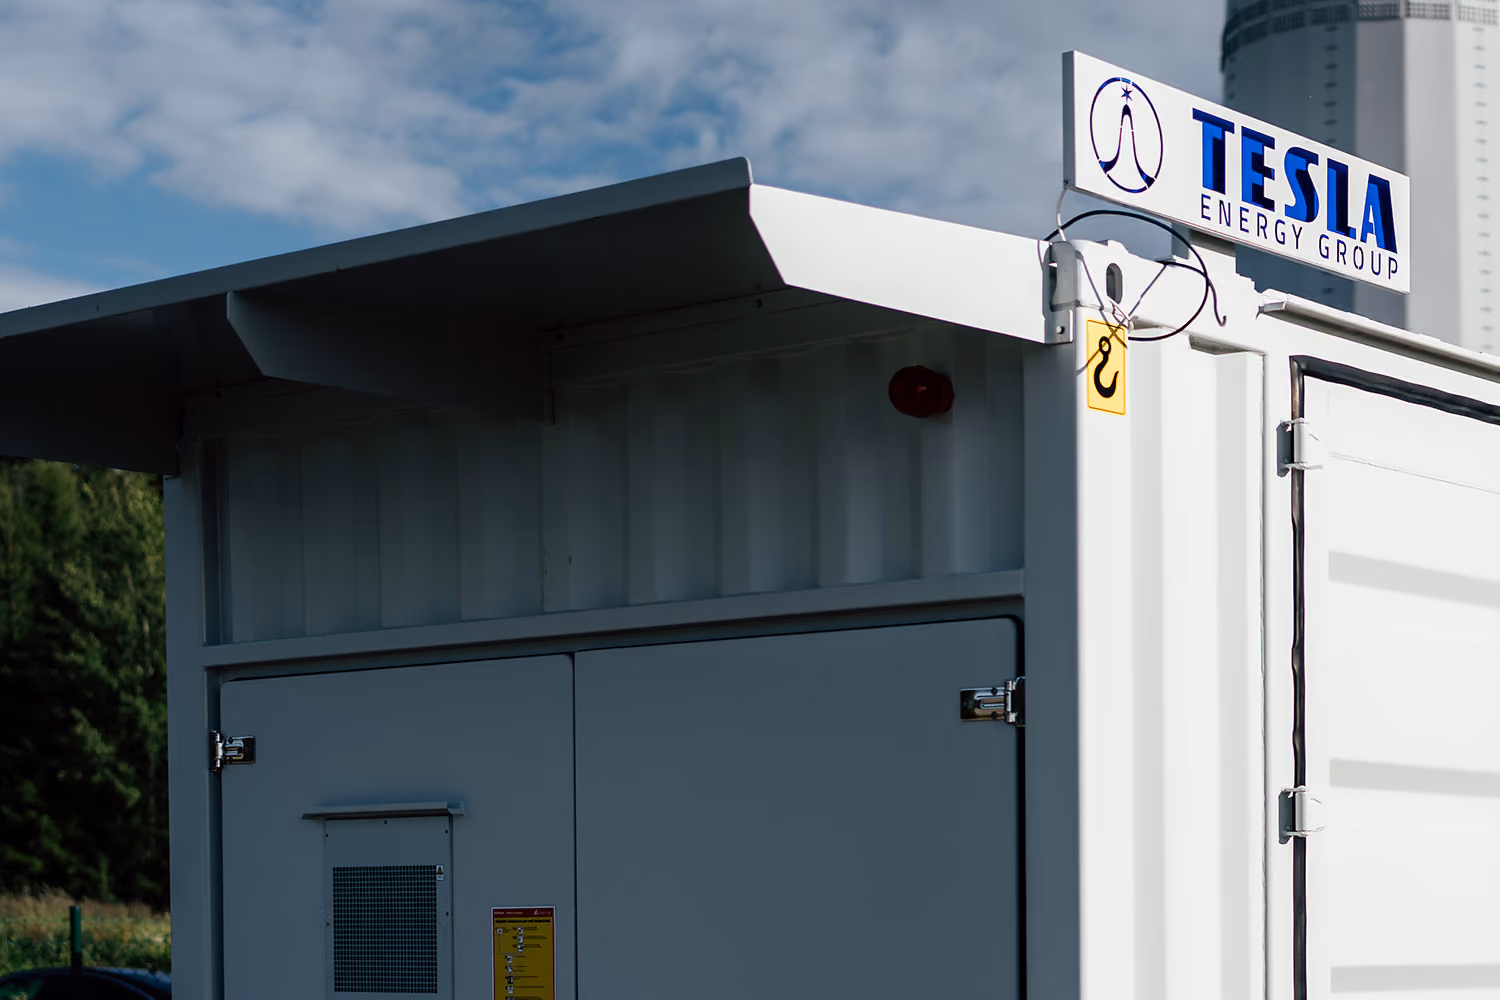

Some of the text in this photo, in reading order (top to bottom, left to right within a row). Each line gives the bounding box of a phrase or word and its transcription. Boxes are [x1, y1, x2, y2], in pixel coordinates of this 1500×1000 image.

[1192, 107, 1398, 254] TESLA
[1201, 193, 1399, 280] ENERGY GROUP
